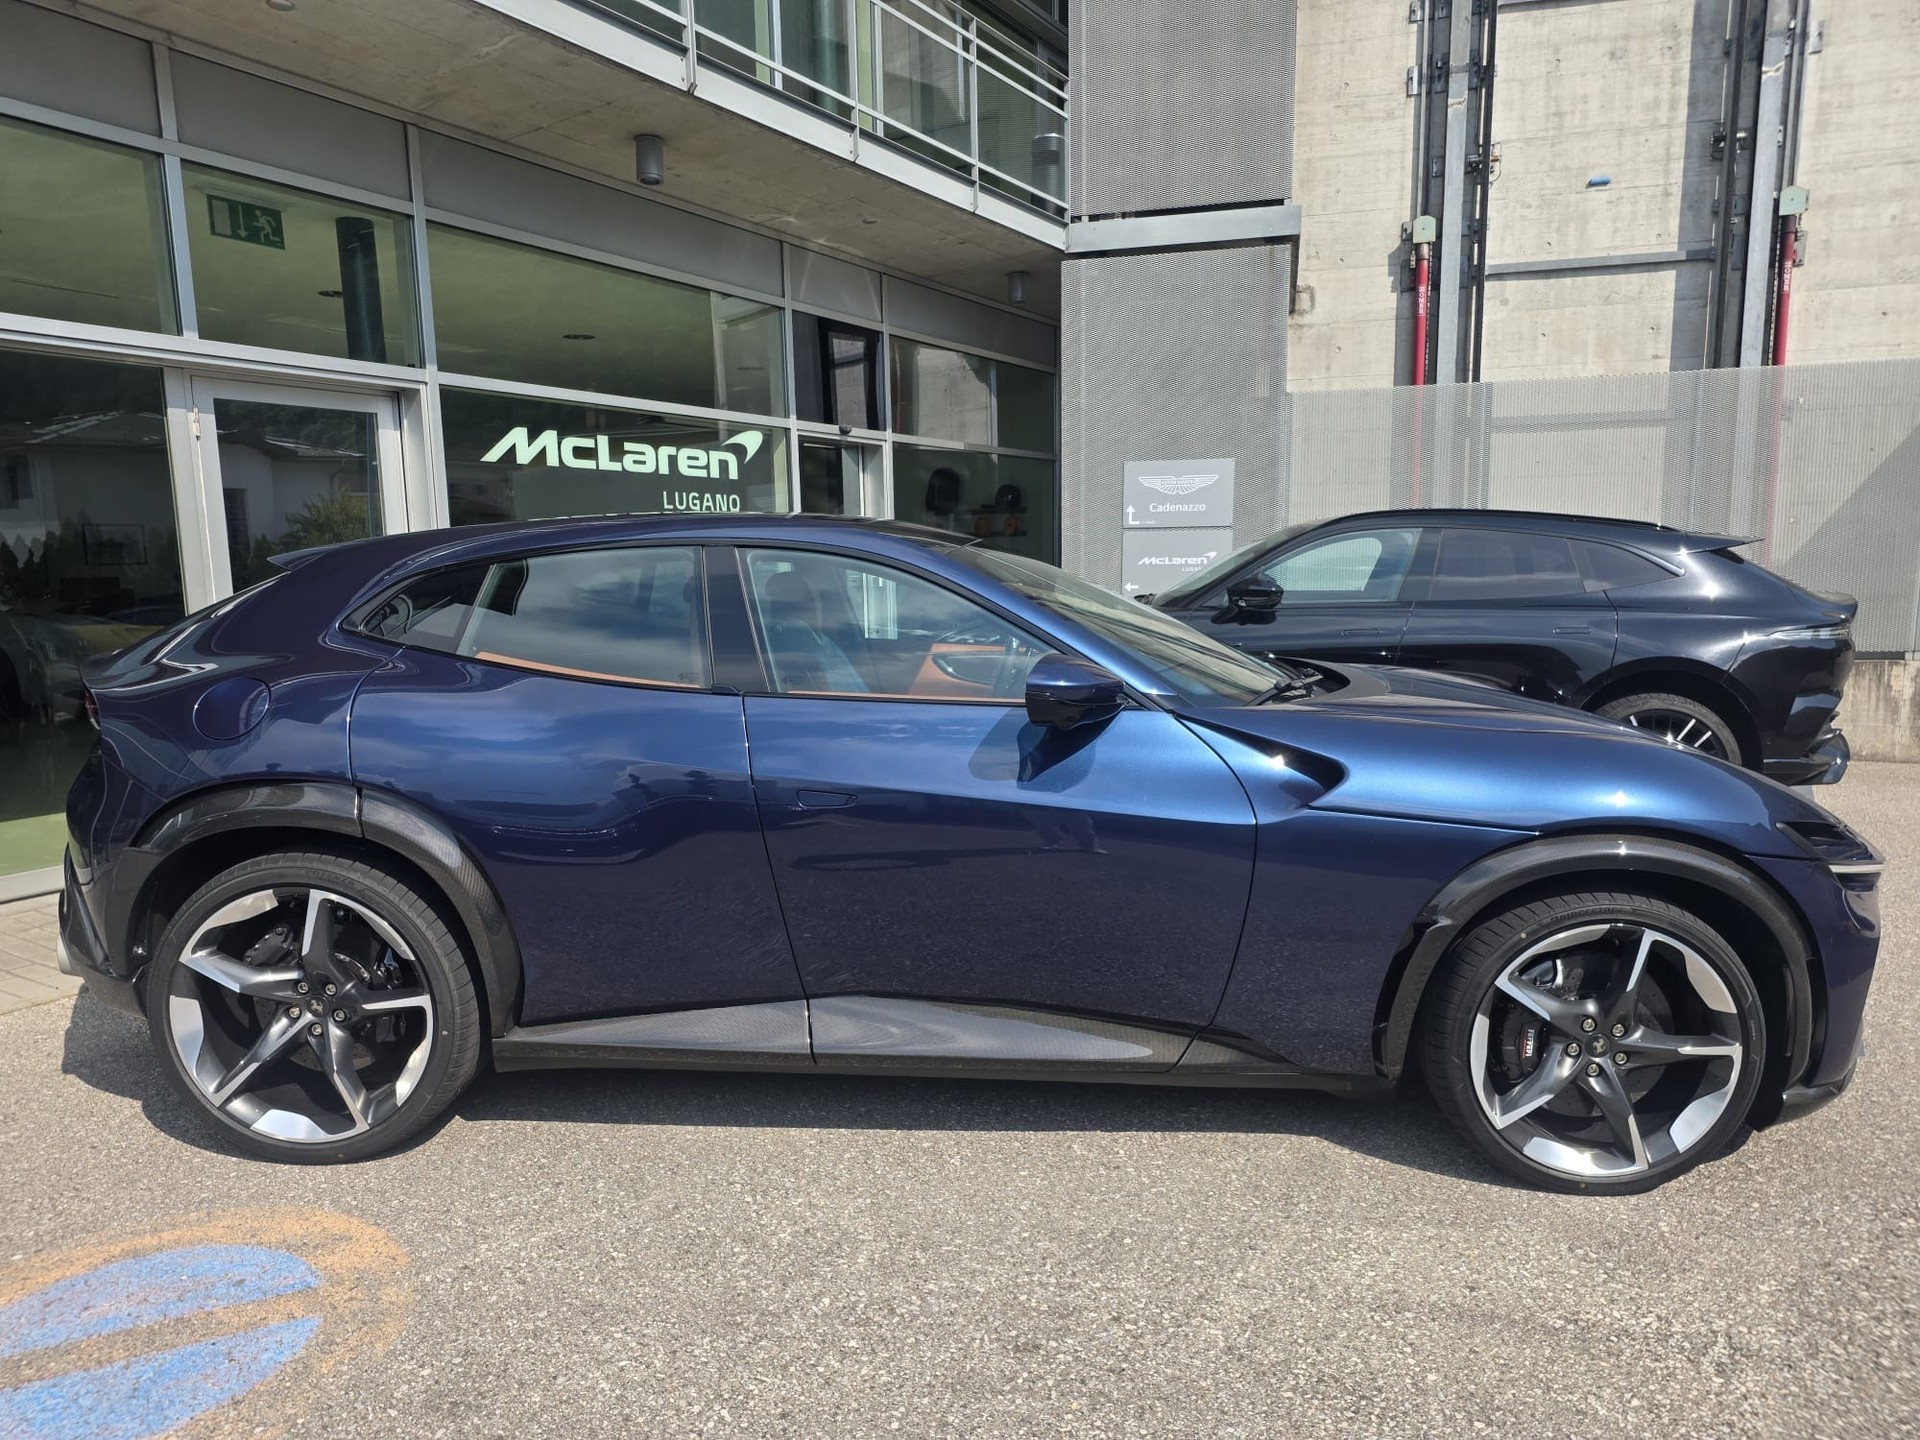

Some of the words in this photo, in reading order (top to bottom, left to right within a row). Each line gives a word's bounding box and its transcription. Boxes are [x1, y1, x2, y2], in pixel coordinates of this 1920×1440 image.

[480, 427, 739, 480] McLaren
[662, 491, 740, 513] LUGANO
[1149, 502, 1207, 512] Cadenazzo
[1137, 556, 1208, 565] McLaren
